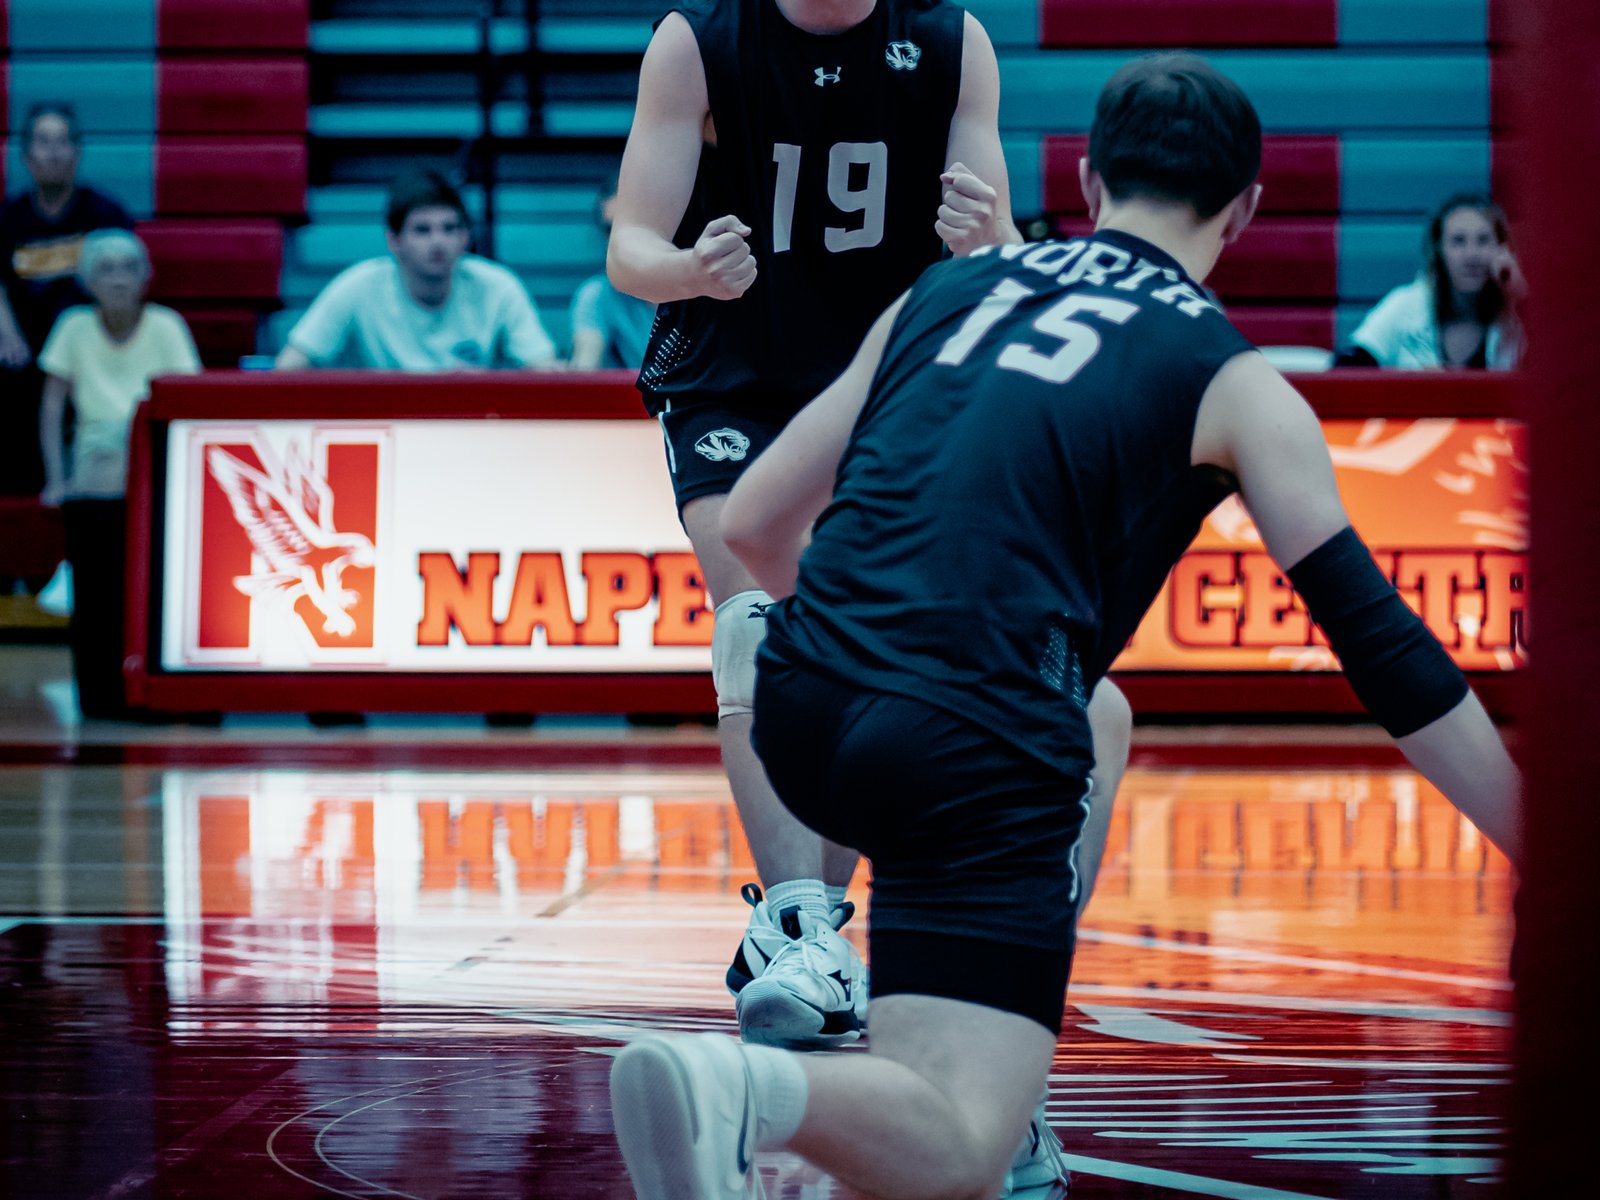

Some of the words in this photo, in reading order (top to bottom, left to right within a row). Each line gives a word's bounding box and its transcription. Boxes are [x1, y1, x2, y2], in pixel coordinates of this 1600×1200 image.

[772, 141, 888, 253] 19
[934, 277, 1141, 384] 15
[417, 551, 714, 647] NAPE
